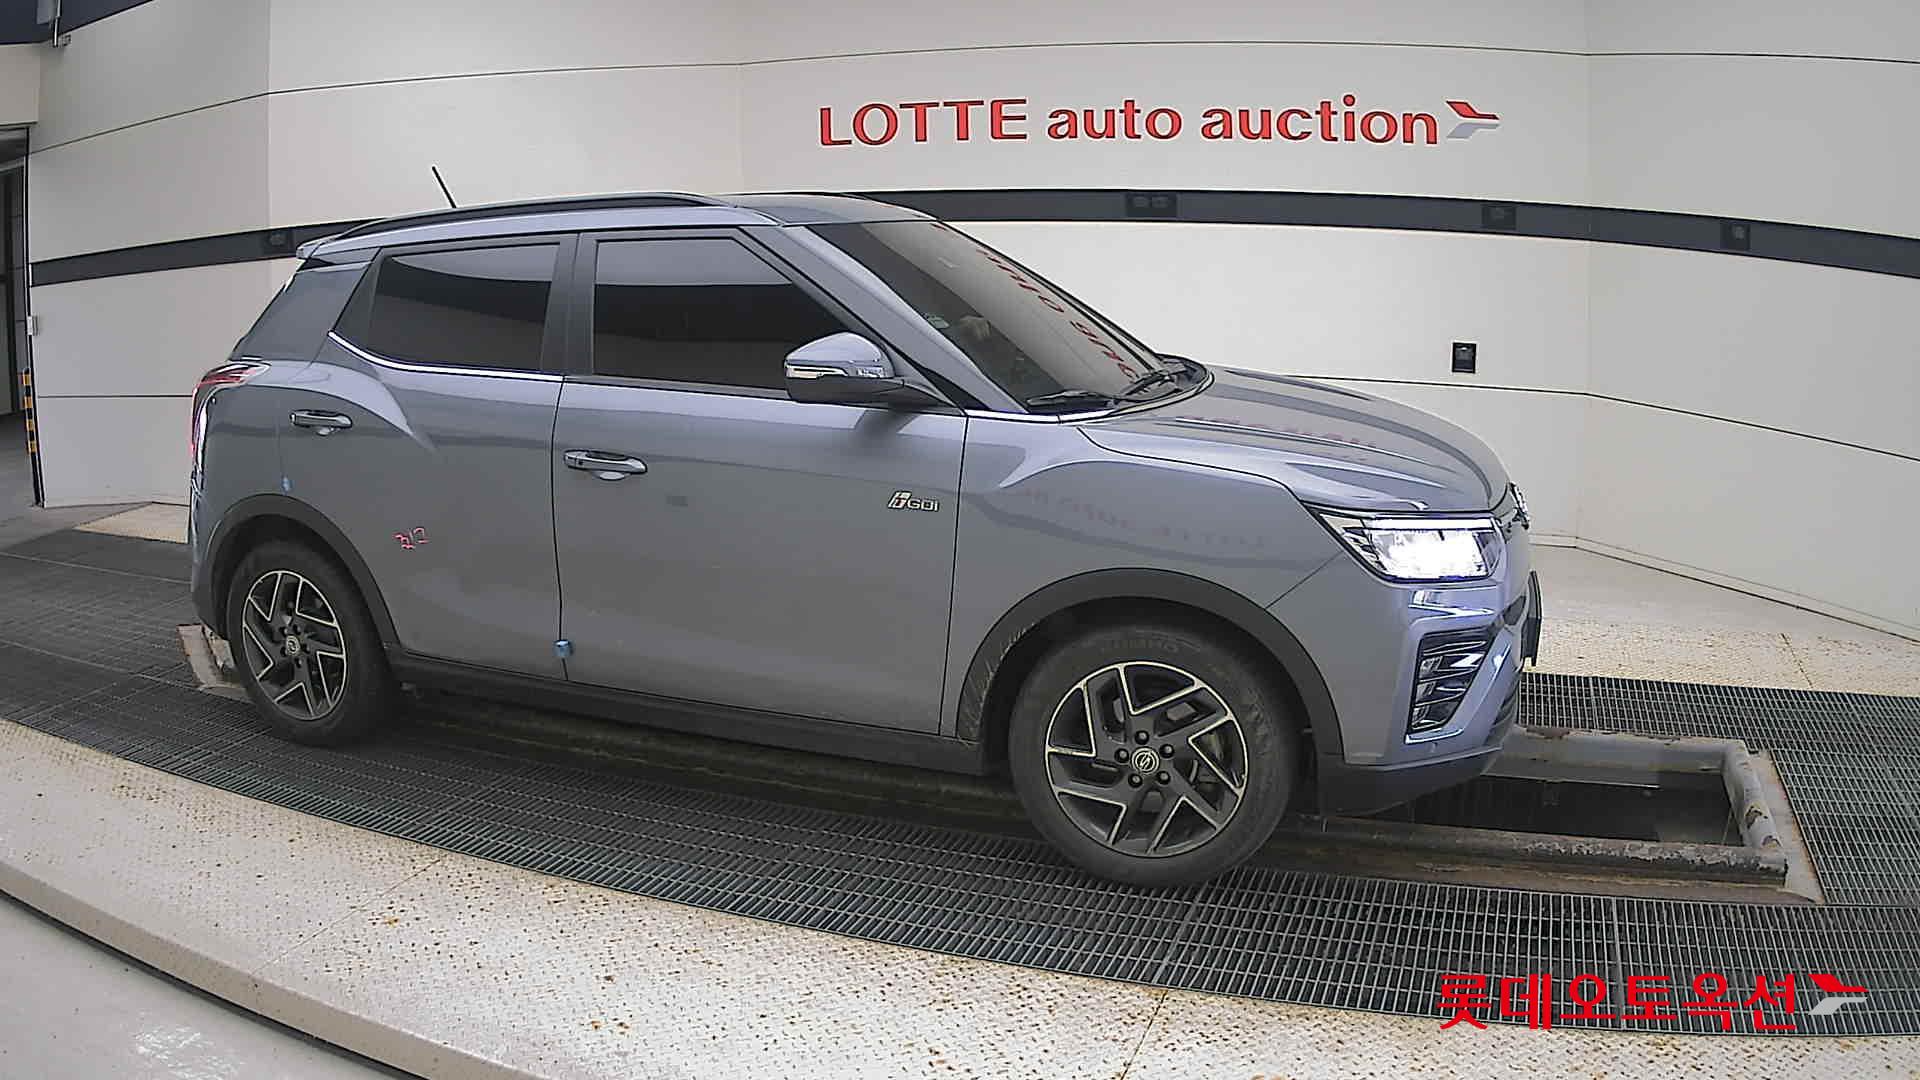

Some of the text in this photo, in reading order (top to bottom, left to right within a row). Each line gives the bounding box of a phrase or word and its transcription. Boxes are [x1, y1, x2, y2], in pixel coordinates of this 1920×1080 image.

[819, 94, 1439, 147] LOTTE auto auction
